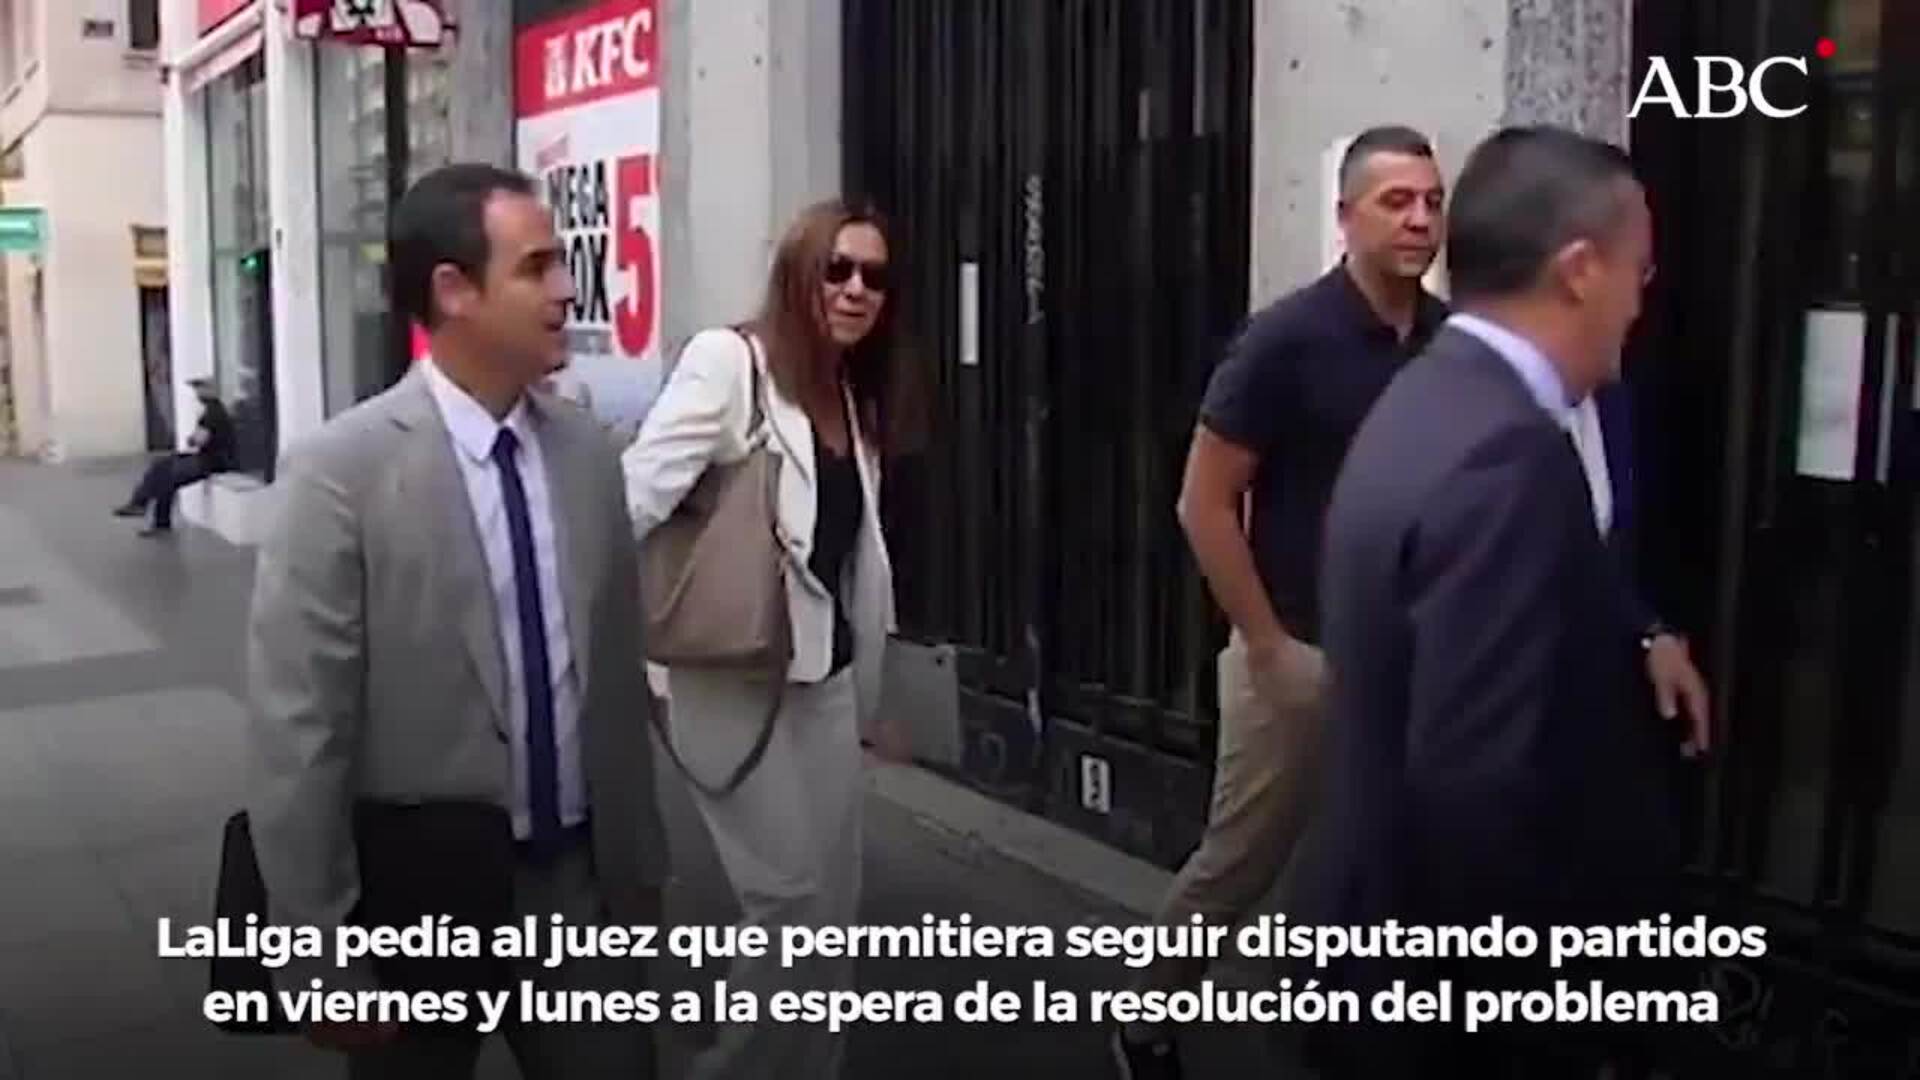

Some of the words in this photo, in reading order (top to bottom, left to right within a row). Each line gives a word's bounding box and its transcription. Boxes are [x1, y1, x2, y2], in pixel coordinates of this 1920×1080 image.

[573, 10, 651, 88] KFC
[564, 233, 610, 323] OX
[615, 153, 655, 359] 5
